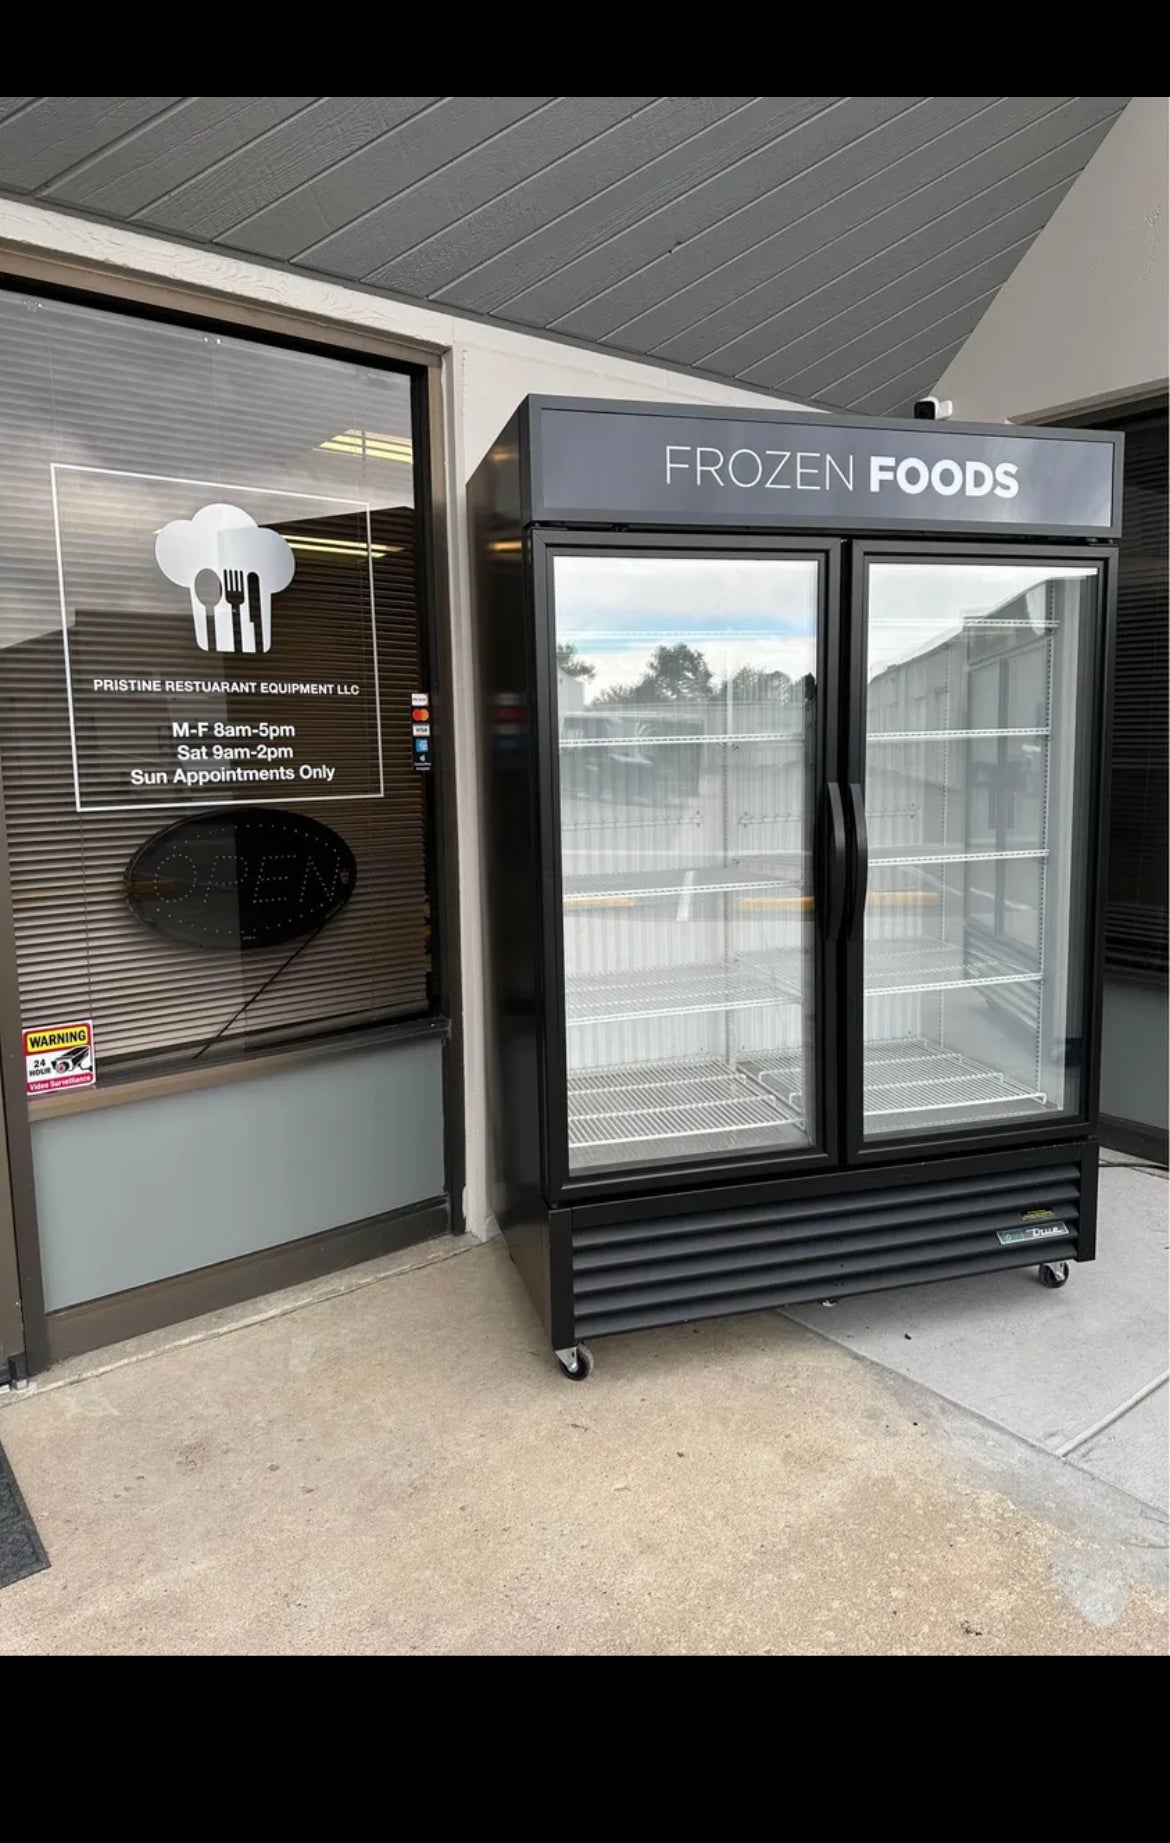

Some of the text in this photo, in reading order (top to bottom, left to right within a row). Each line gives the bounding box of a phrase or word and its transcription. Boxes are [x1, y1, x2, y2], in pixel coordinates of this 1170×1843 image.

[664, 445, 1020, 499] FROZEN FOODS
[93, 679, 360, 696] PRISTINE RESTUARANT EQUIPMENT LLC
[172, 722, 296, 740] M-F 8am-5pm
[177, 744, 294, 762] Sat 9am-2pm
[131, 764, 336, 786] Sun Appointments Only
[153, 853, 341, 904] OPEN
[28, 1029, 87, 1049] WARNING
[29, 1067, 52, 1077] HOUR
[33, 1058, 46, 1068] 24
[29, 1075, 92, 1091] Video Surveillance
